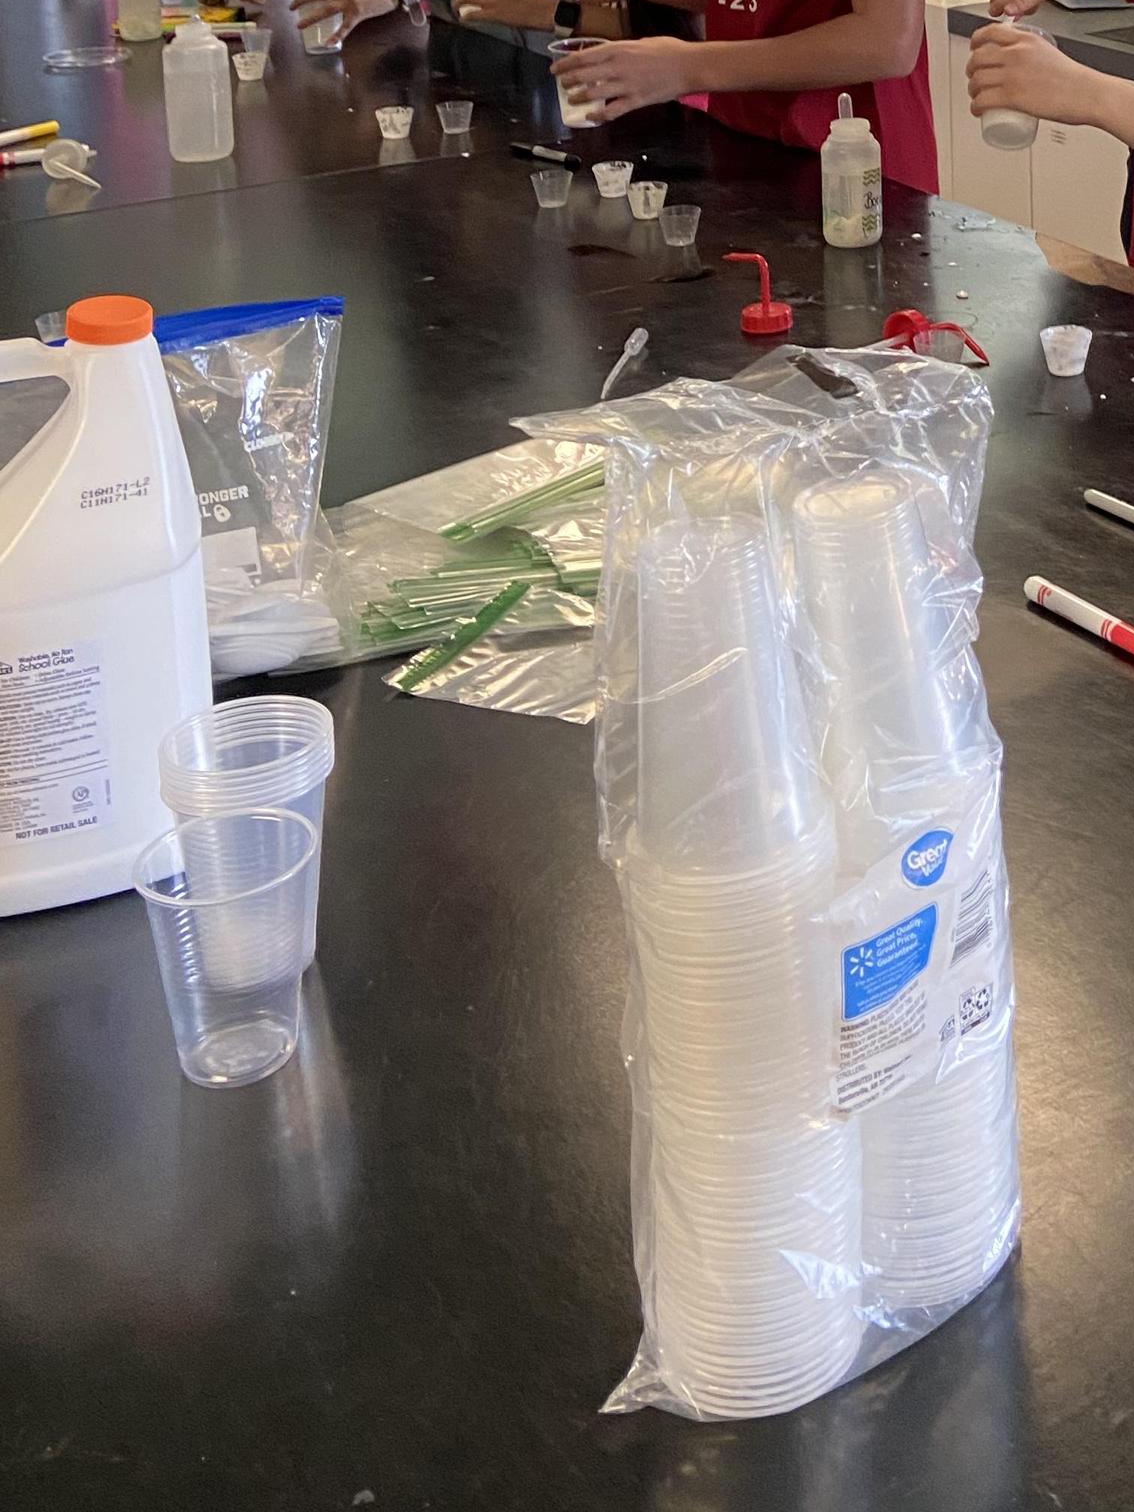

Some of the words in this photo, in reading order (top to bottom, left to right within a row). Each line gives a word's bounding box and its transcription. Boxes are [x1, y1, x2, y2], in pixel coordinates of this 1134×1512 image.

[199, 485, 249, 506] ONGER
[18, 659, 51, 673] School
[52, 656, 75, 667] Glue
[16, 831, 31, 840] NOT
[33, 828, 48, 837] FOR
[50, 822, 77, 834] RETAIL
[78, 816, 98, 828] SALE
